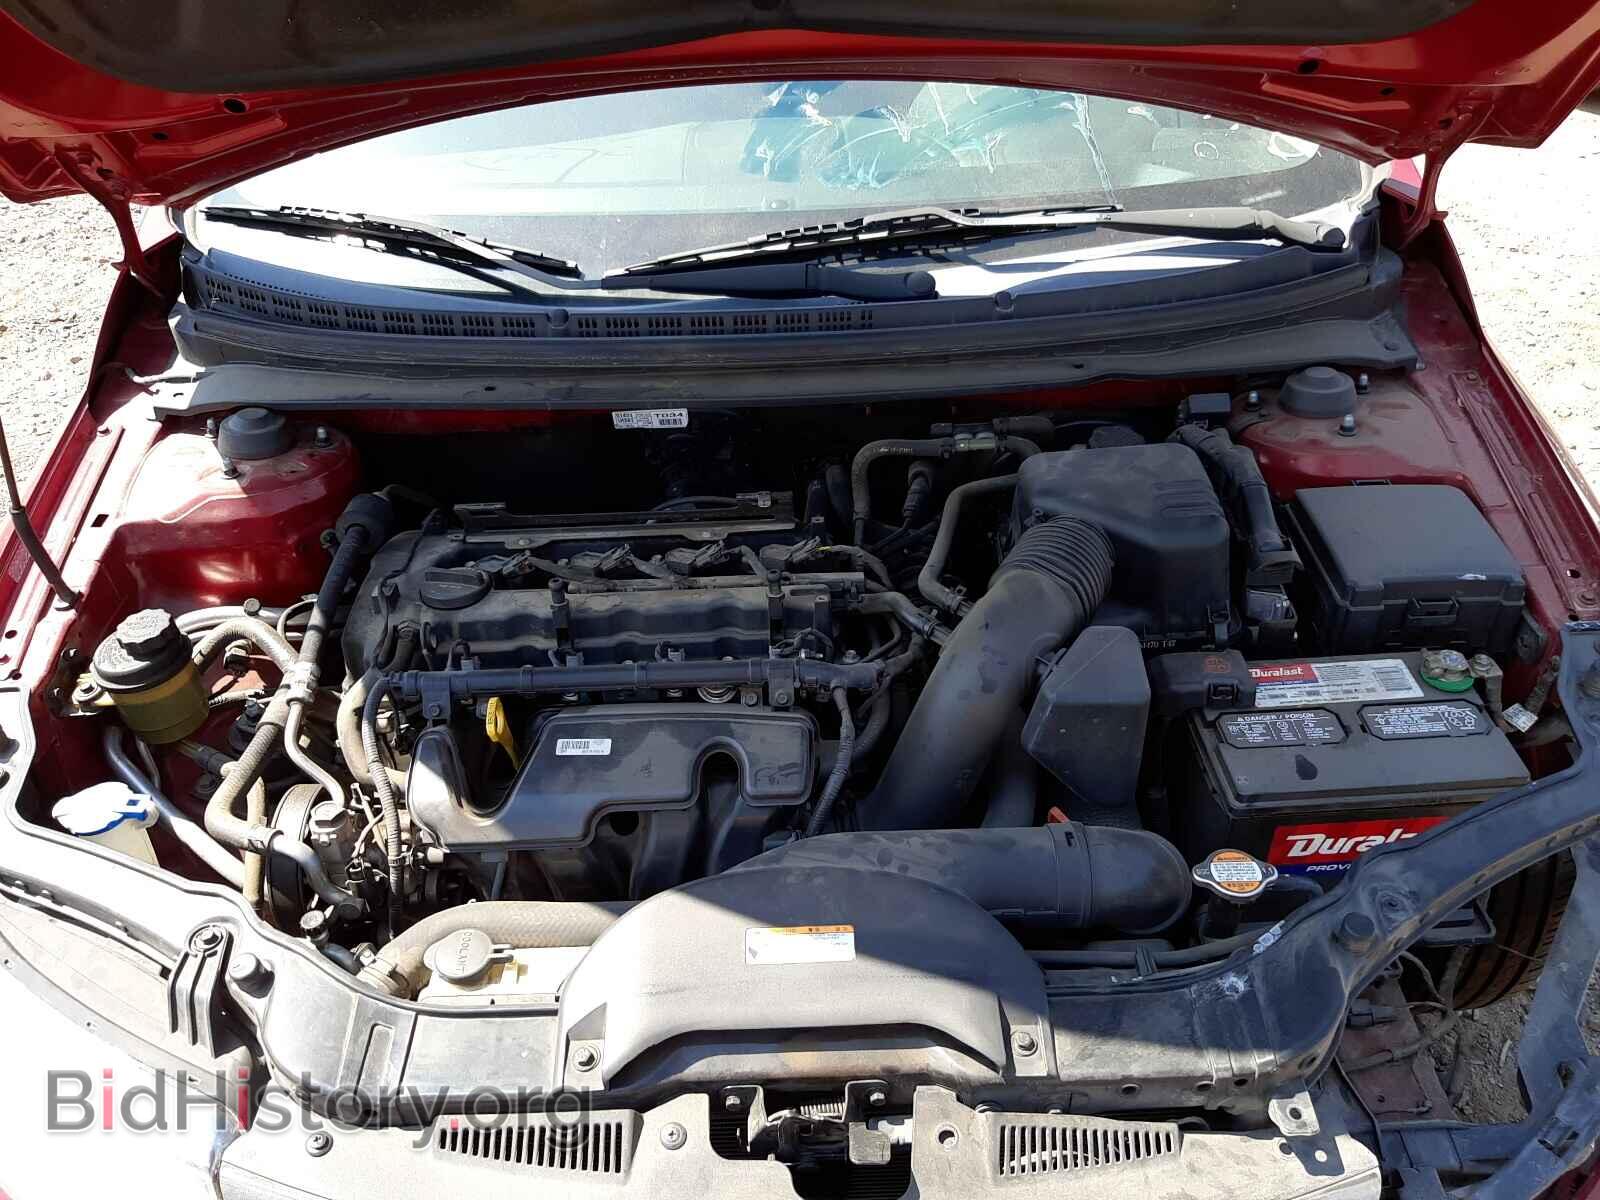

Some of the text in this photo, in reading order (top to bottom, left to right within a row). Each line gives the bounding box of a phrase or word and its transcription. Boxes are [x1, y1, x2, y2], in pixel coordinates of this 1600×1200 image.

[1249, 666, 1304, 678] Duralast
[1245, 713, 1277, 721] DANGER
[1285, 711, 1314, 719] POISON
[1286, 829, 1418, 857] Dural
